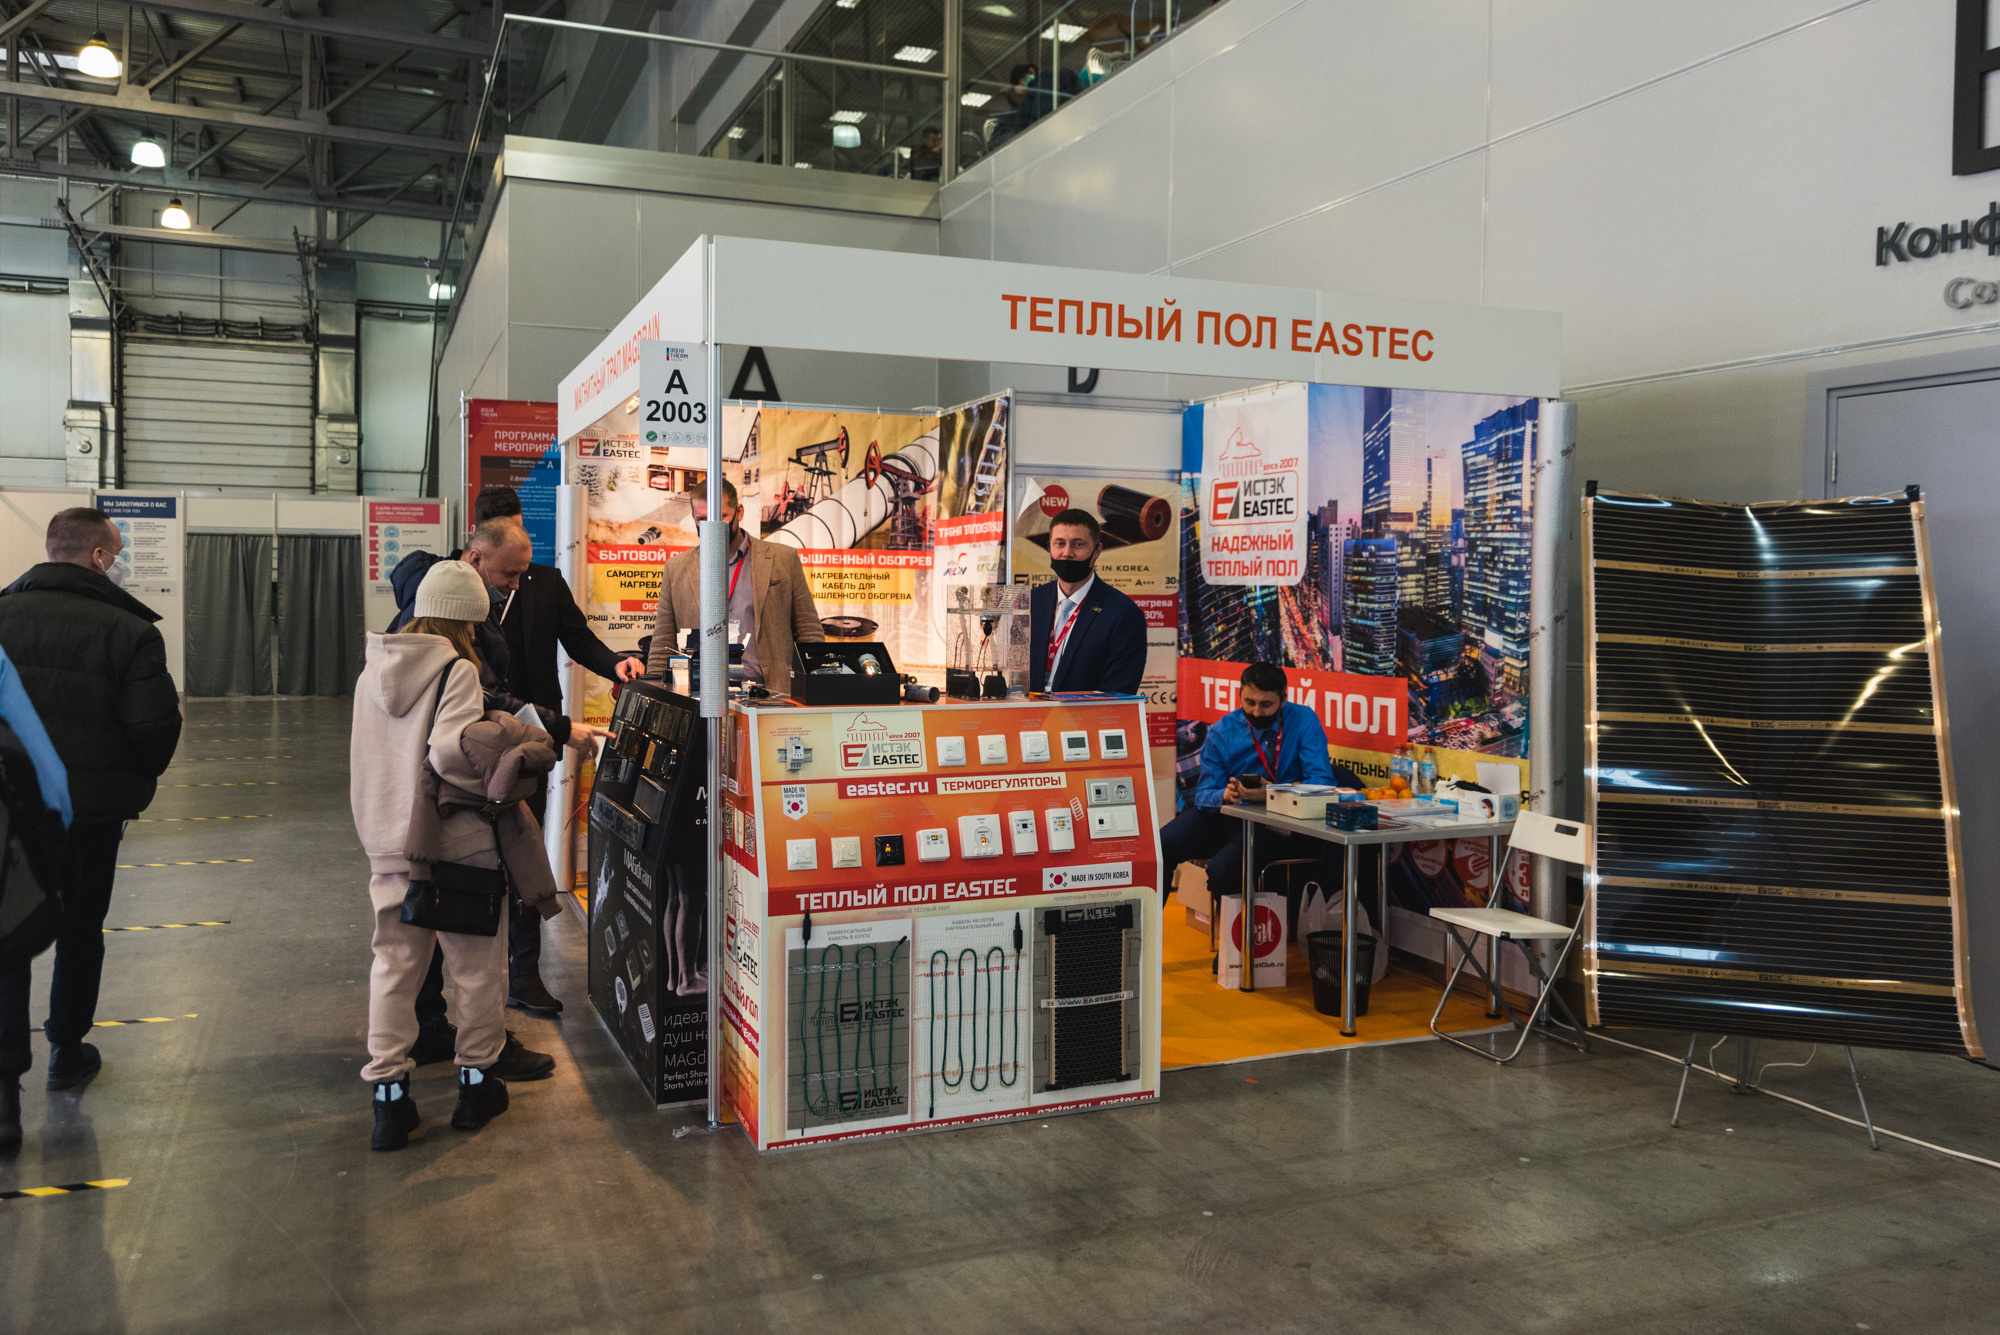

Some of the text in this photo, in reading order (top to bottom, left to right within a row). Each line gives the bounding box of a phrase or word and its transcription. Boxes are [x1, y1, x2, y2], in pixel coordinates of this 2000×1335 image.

[1001, 293, 1434, 362] ТЕПЛЫЙ ПОЛ EASTEC
[574, 358, 606, 412] МАГНИТНЫЙ
[606, 348, 622, 387] ТРАП
[664, 369, 689, 394] A
[646, 400, 707, 424] 2003
[494, 430, 556, 442] ПРОГРАММА
[494, 442, 561, 453] МЕРОПРИЯТИ
[602, 439, 635, 449] ИСТЭК
[602, 448, 640, 458] EASTEC
[1263, 458, 1299, 470] since 2007
[1243, 476, 1286, 497] ИСТЭК
[1042, 497, 1068, 507] NEW
[1243, 498, 1294, 518] EASTEC
[1211, 529, 1294, 555] НАДЕЖНЫЙ
[599, 548, 666, 561] БЫТОВОЙ
[800, 552, 932, 566] ЫШЛЕННЫЙ ОБОГРЕВ
[1206, 556, 1298, 576] ТЕПЛЫЙ ПОЛ
[606, 570, 664, 578] САМОРЕГУЛ
[810, 571, 890, 580] НАГРЕВАТЕЛЬНЫЙ
[1165, 576, 1178, 584] 30
[1135, 600, 1173, 608] регрева
[1144, 610, 1164, 620] 30%
[1324, 691, 1397, 736] ПОЛ
[872, 742, 912, 754] ИСТЭК
[874, 754, 920, 766] EASTEC
[846, 781, 929, 796] eastec.ru
[942, 776, 1062, 792] ТЕРМОРЕГУЛЯТОРЫ
[1072, 874, 1087, 882] MADE
[1095, 872, 1112, 880] SOUTH
[1112, 871, 1130, 880] KOREA
[796, 878, 1017, 911] ТЕПЛЫЙ ПОЛ EASTEC
[1054, 894, 1088, 902] ПЛЕНОЧНЫЙ
[1088, 892, 1110, 900] ТЕПЛЫЙ
[877, 908, 912, 916] КАБЕЛЬНЫЙ
[914, 905, 937, 913] ТЕПЛЫЙ
[826, 927, 872, 936] УНИВЕРСАЛЬНЫЙ
[664, 1012, 708, 1028] идеал
[664, 1031, 692, 1048] душ
[665, 1049, 706, 1068] MAGd
[664, 1070, 708, 1081] Perfect Show
[664, 1078, 704, 1090] Starts With
